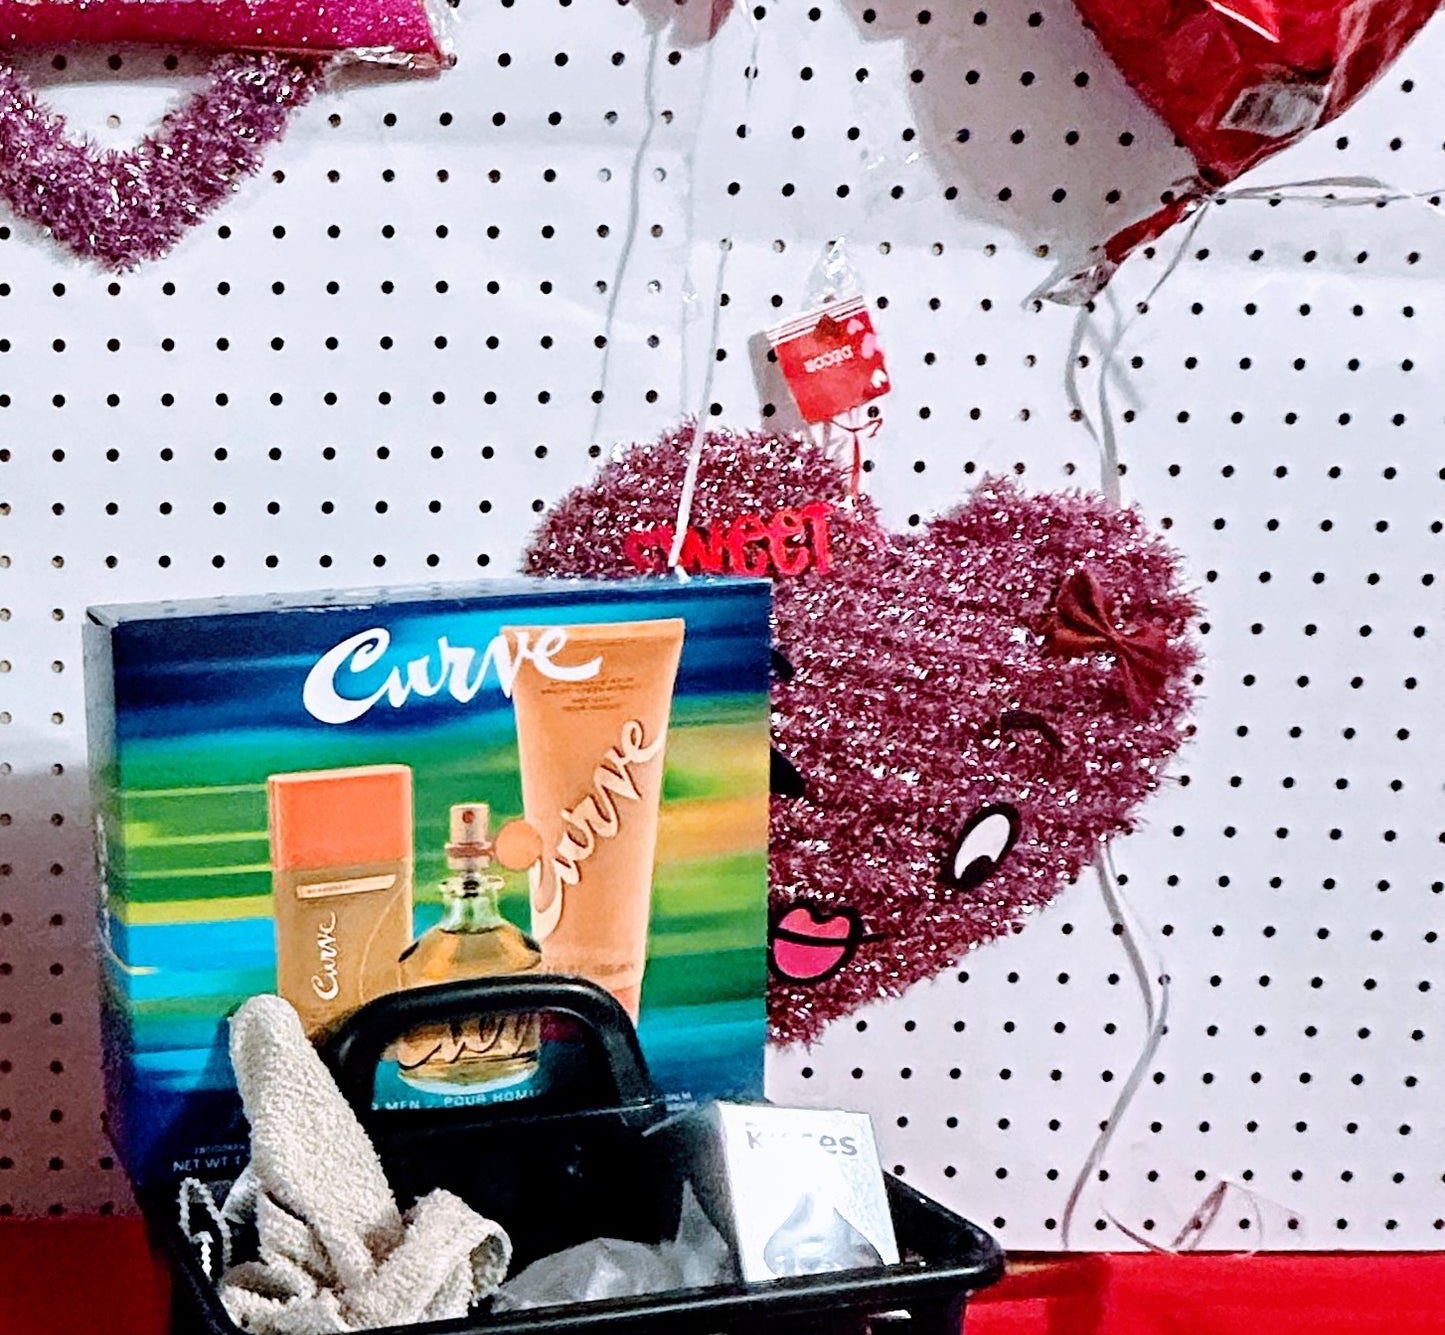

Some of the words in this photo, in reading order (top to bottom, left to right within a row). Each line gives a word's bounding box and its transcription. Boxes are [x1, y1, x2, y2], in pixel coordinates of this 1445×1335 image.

[303, 627, 602, 724] Curve
[532, 719, 666, 941] Curve
[310, 911, 340, 1001] Curve
[444, 1093, 487, 1107] POUR
[492, 1089, 541, 1104] HOM
[172, 1158, 200, 1172] NET
